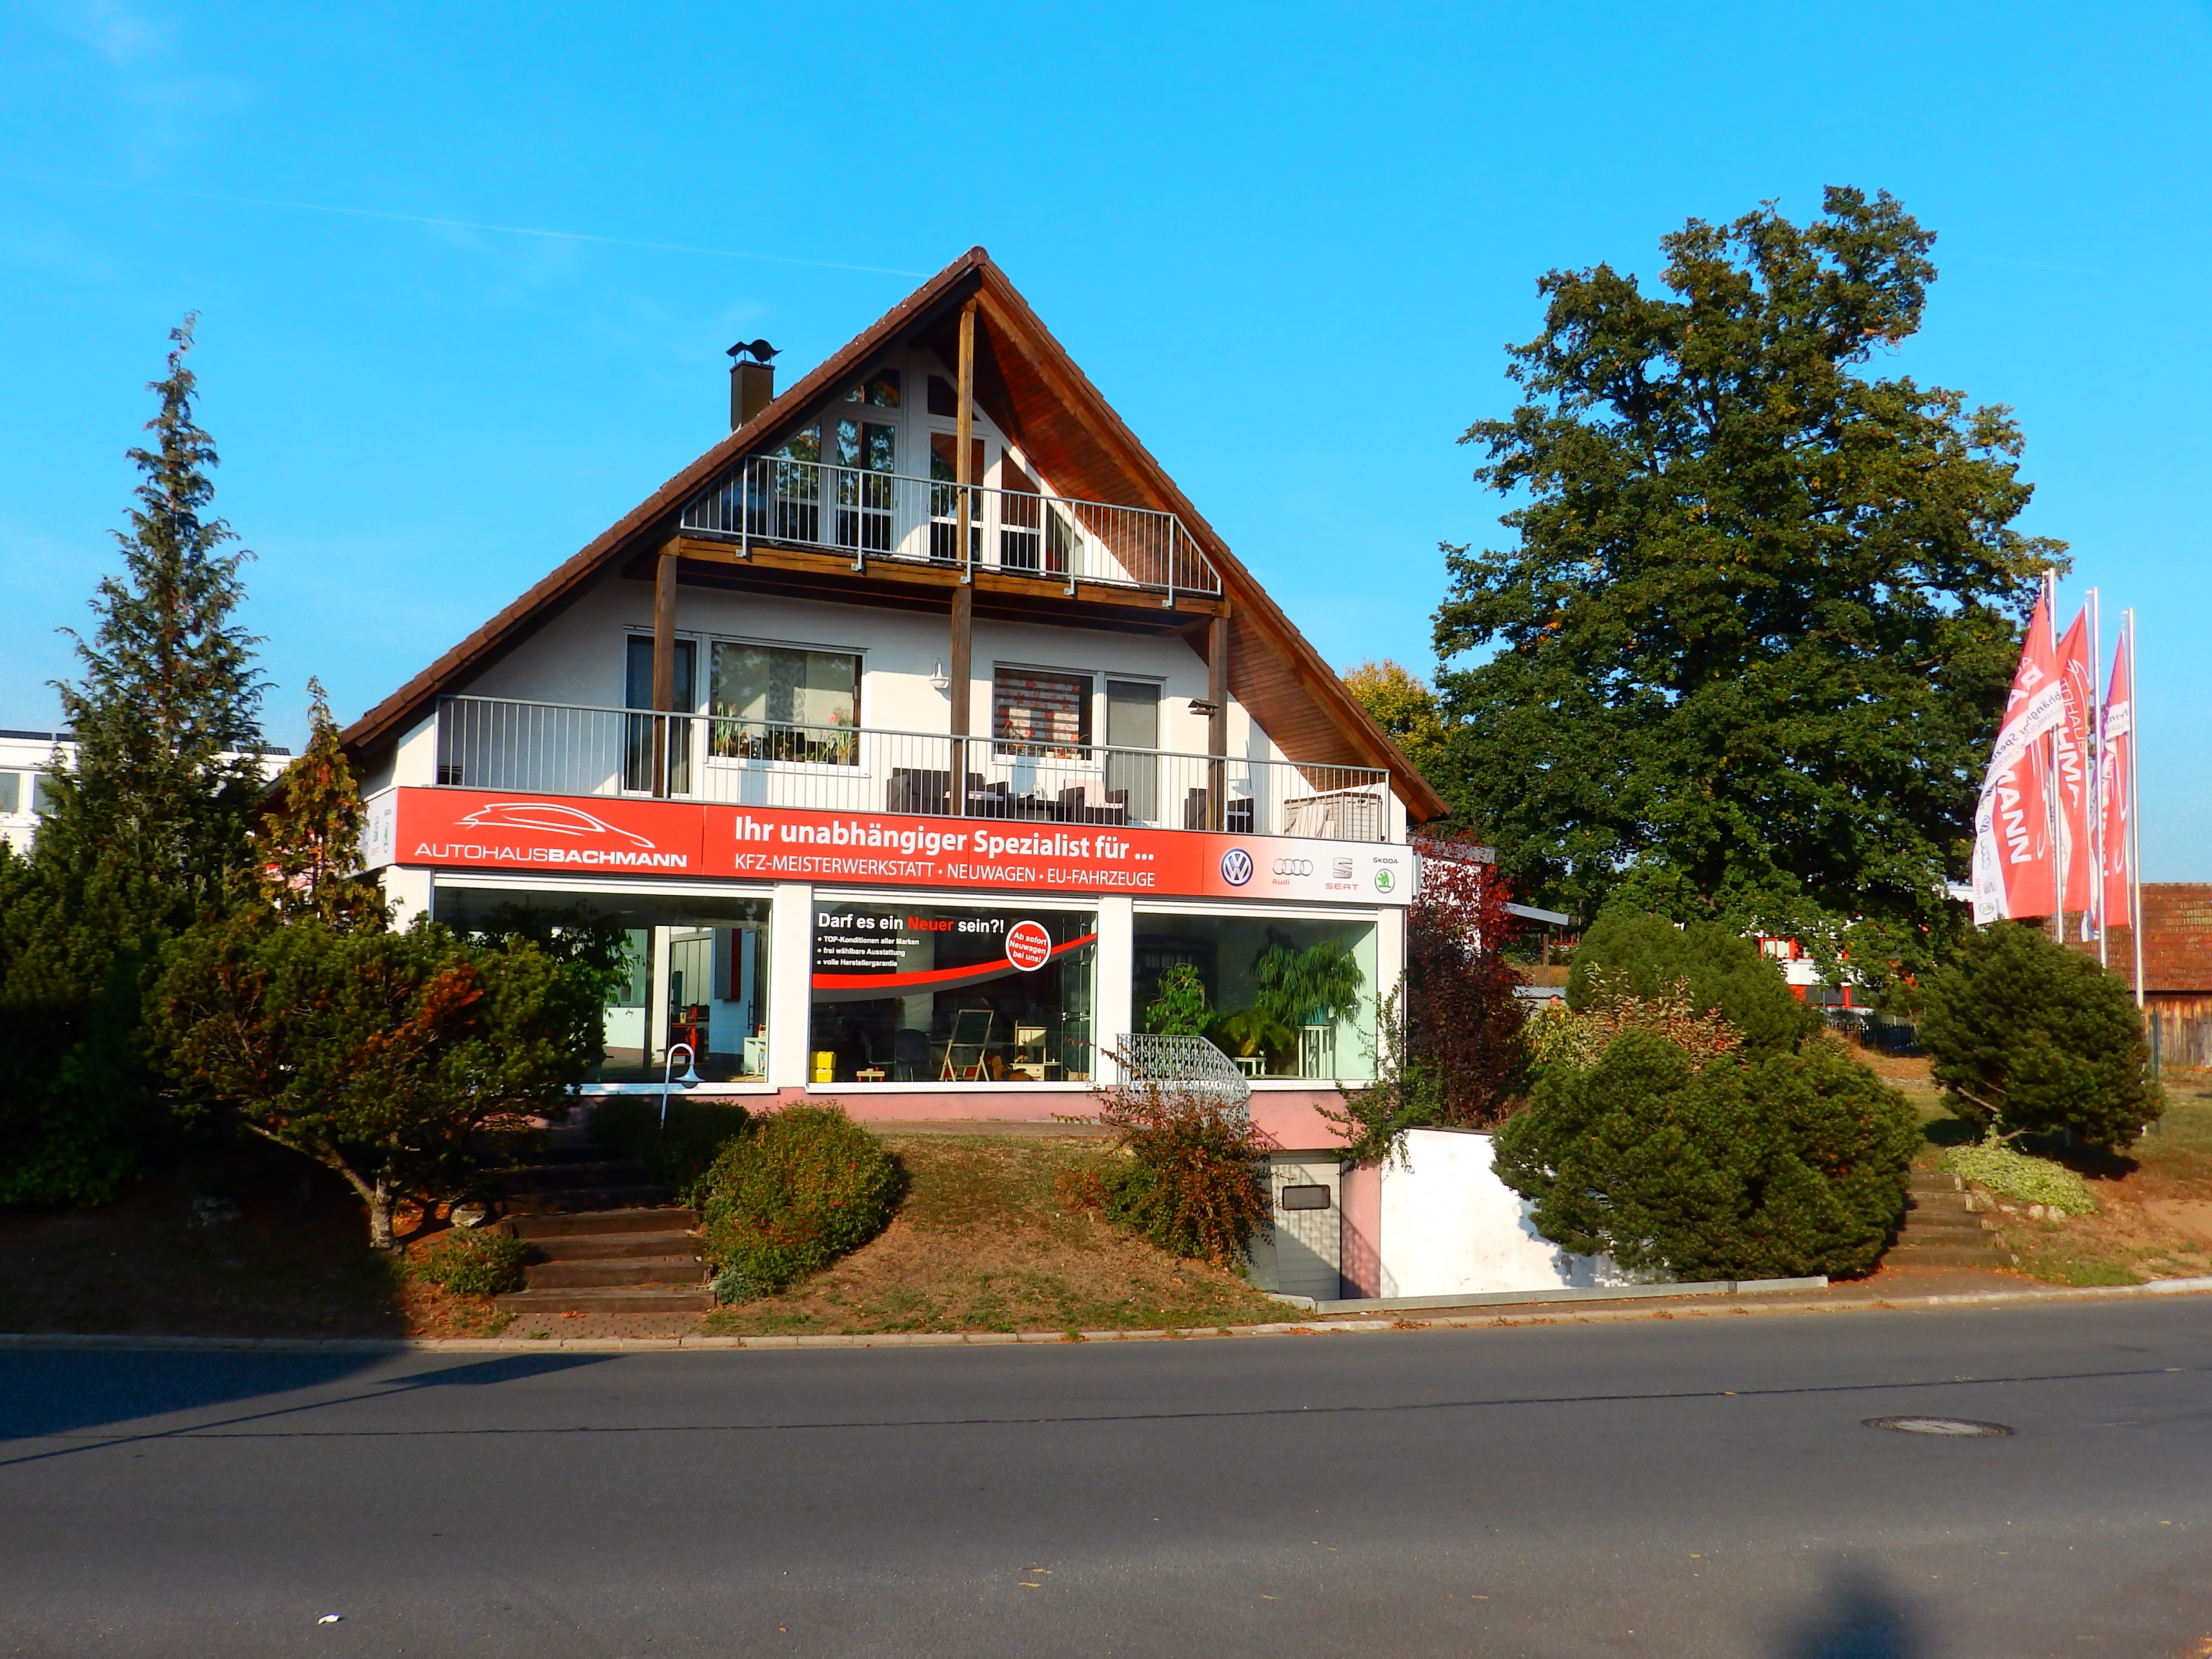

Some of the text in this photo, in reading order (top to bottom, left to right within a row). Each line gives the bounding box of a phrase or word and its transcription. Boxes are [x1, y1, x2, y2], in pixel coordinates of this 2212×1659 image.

[735, 815, 774, 841] Ihr
[781, 820, 967, 856] unabhängiger
[974, 830, 1090, 859] Spezialist
[1094, 835, 1130, 859] für
[735, 853, 1155, 887] KFZ-MEISTERWERKSTATT NEUWAGEN EU-FAHRZEUGE
[819, 913, 1004, 933] Darf es ein Neuer sein?!
[1025, 935, 1047, 945] sofort
[866, 948, 906, 957] Ausstattung
[1010, 940, 1046, 954] Neuwagen
[1013, 950, 1041, 963] bei uns!
[840, 959, 898, 968] Herstellergarantie
